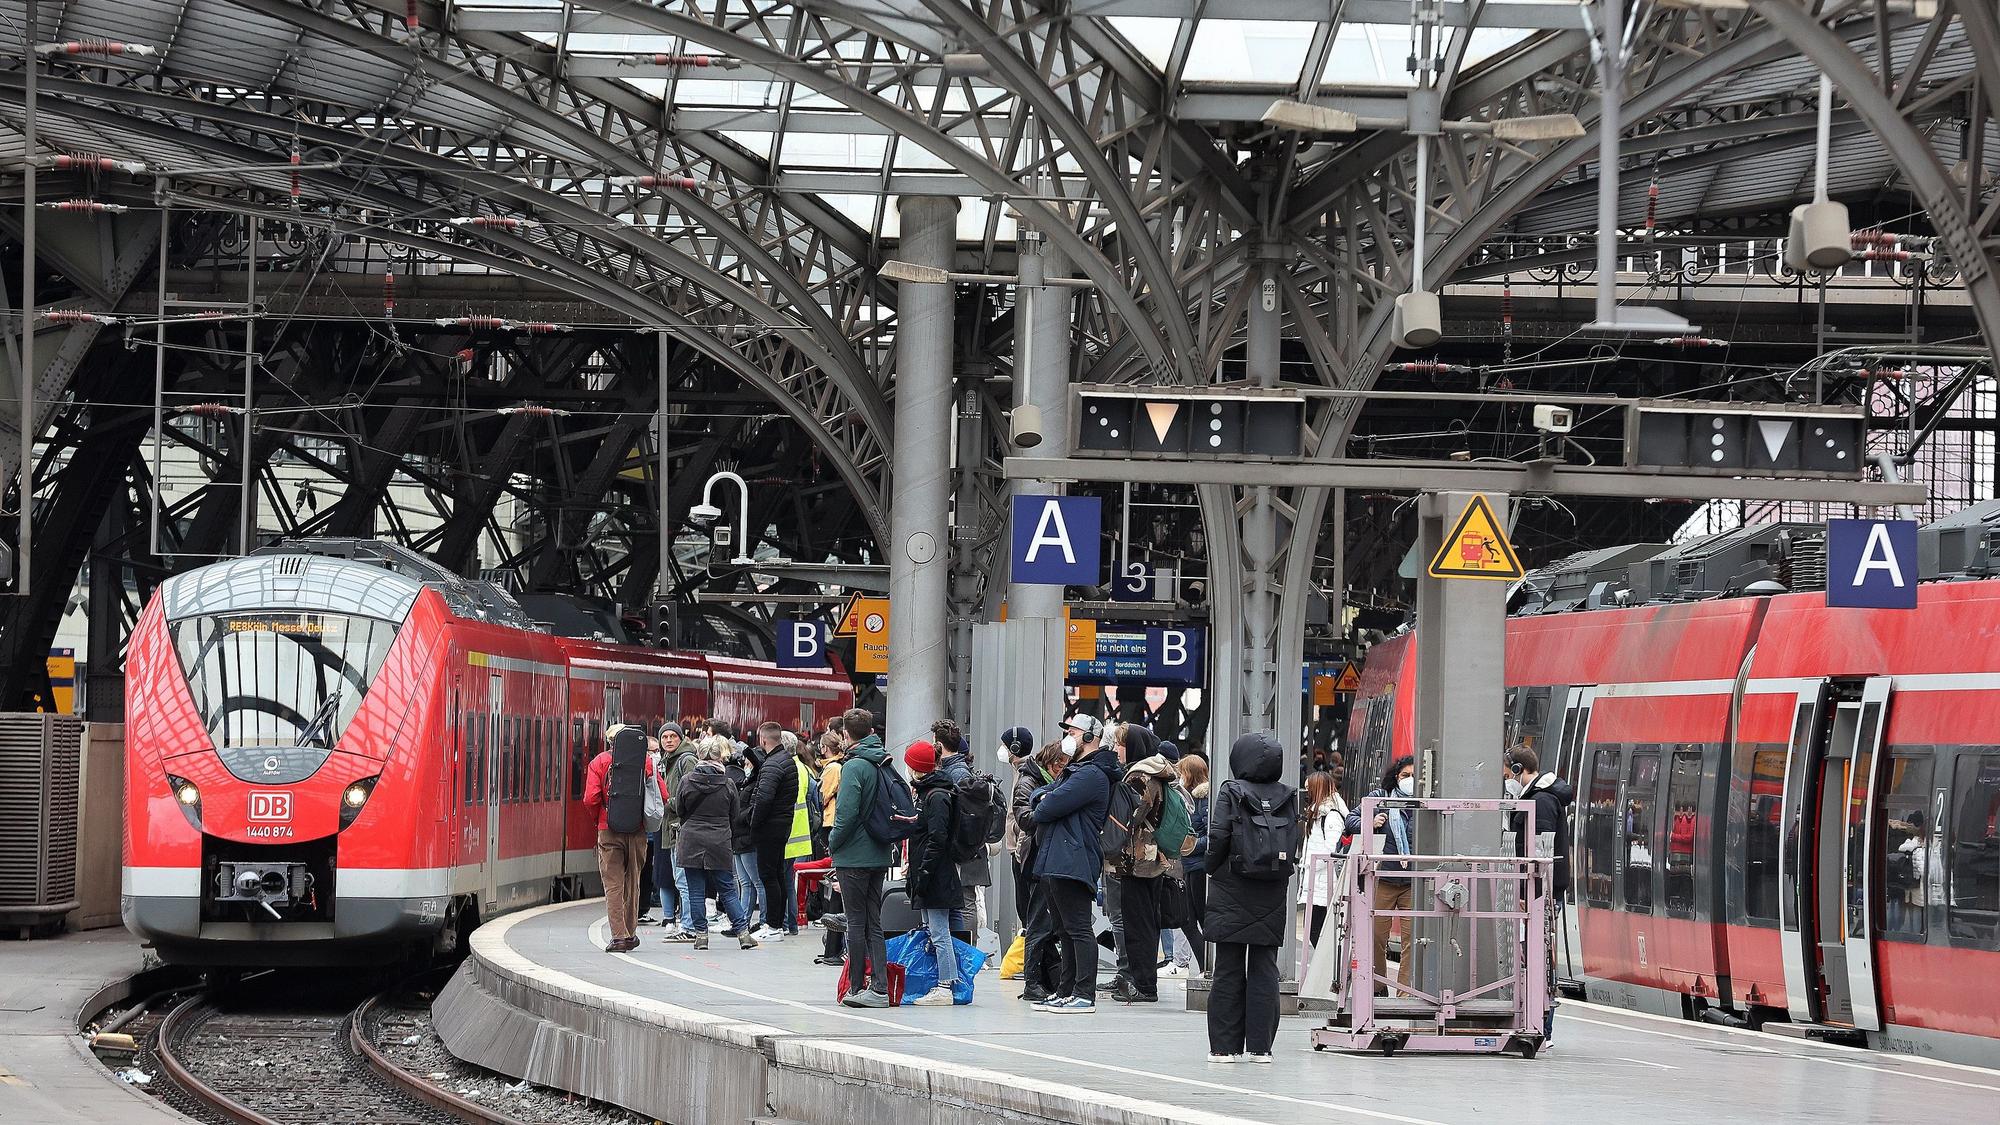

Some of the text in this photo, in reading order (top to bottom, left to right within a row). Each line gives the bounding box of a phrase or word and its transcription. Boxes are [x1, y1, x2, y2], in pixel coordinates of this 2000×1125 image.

[1025, 500, 1077, 564] A
[1852, 523, 1905, 587] A
[1126, 562, 1146, 593] 3
[794, 622, 818, 657] B
[1110, 644, 1128, 652] nicht
[1162, 630, 1188, 666] B
[253, 796, 288, 816] DB
[1936, 792, 1944, 832] 2
[246, 826, 294, 837] 1440 874
